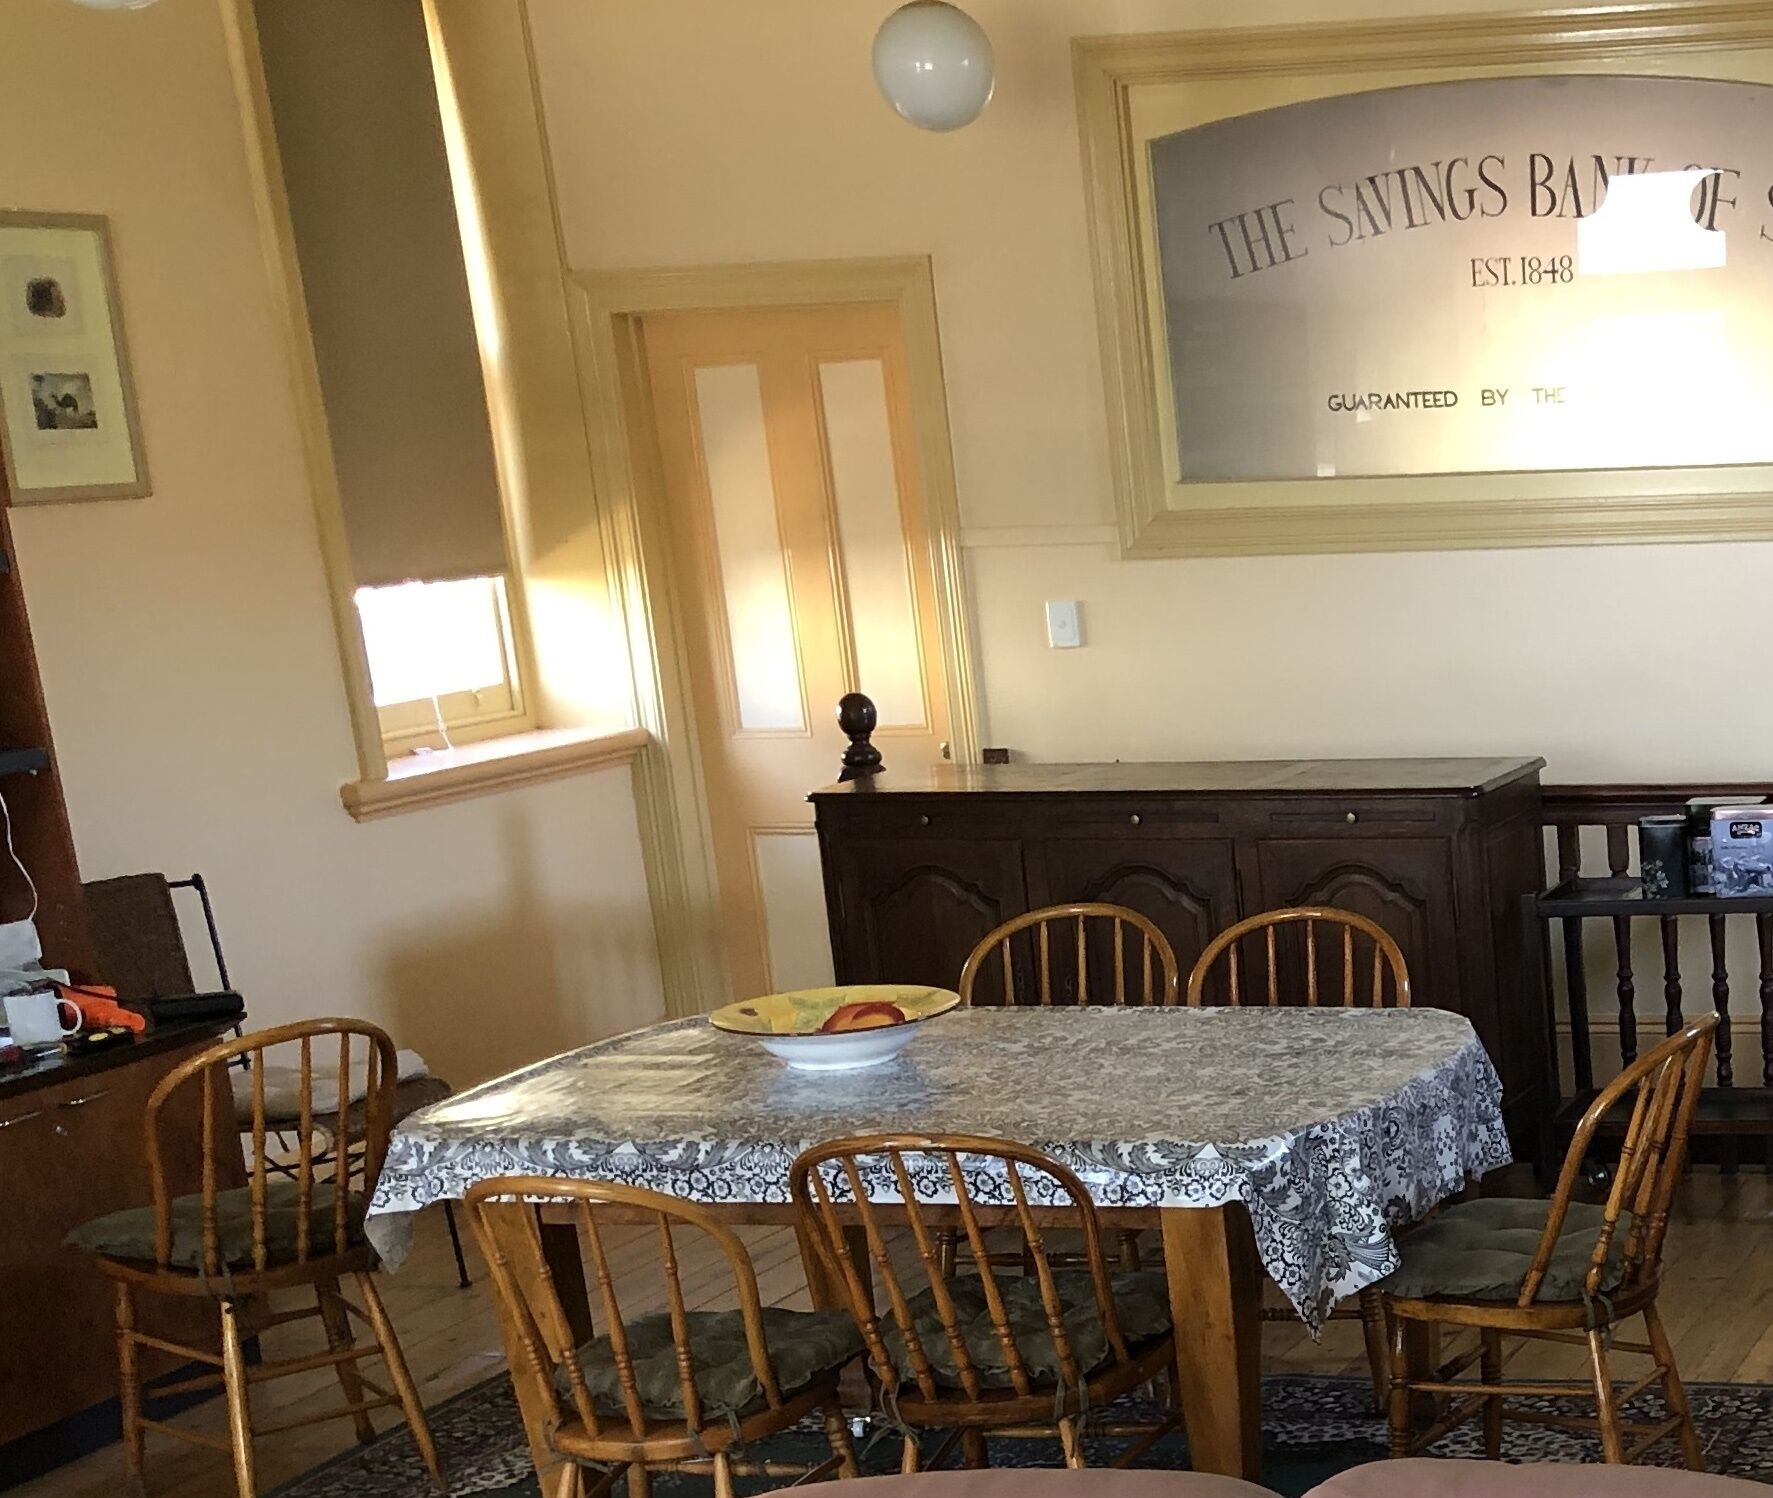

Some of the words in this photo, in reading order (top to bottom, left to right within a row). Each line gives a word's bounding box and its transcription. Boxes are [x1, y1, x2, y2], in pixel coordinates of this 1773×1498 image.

[1208, 198, 1309, 280] THE
[1318, 155, 1508, 248] SAVINGS
[1328, 390, 1459, 412] GUARANTEED
[1481, 388, 1519, 407] BY
[1531, 387, 1567, 405] THE
